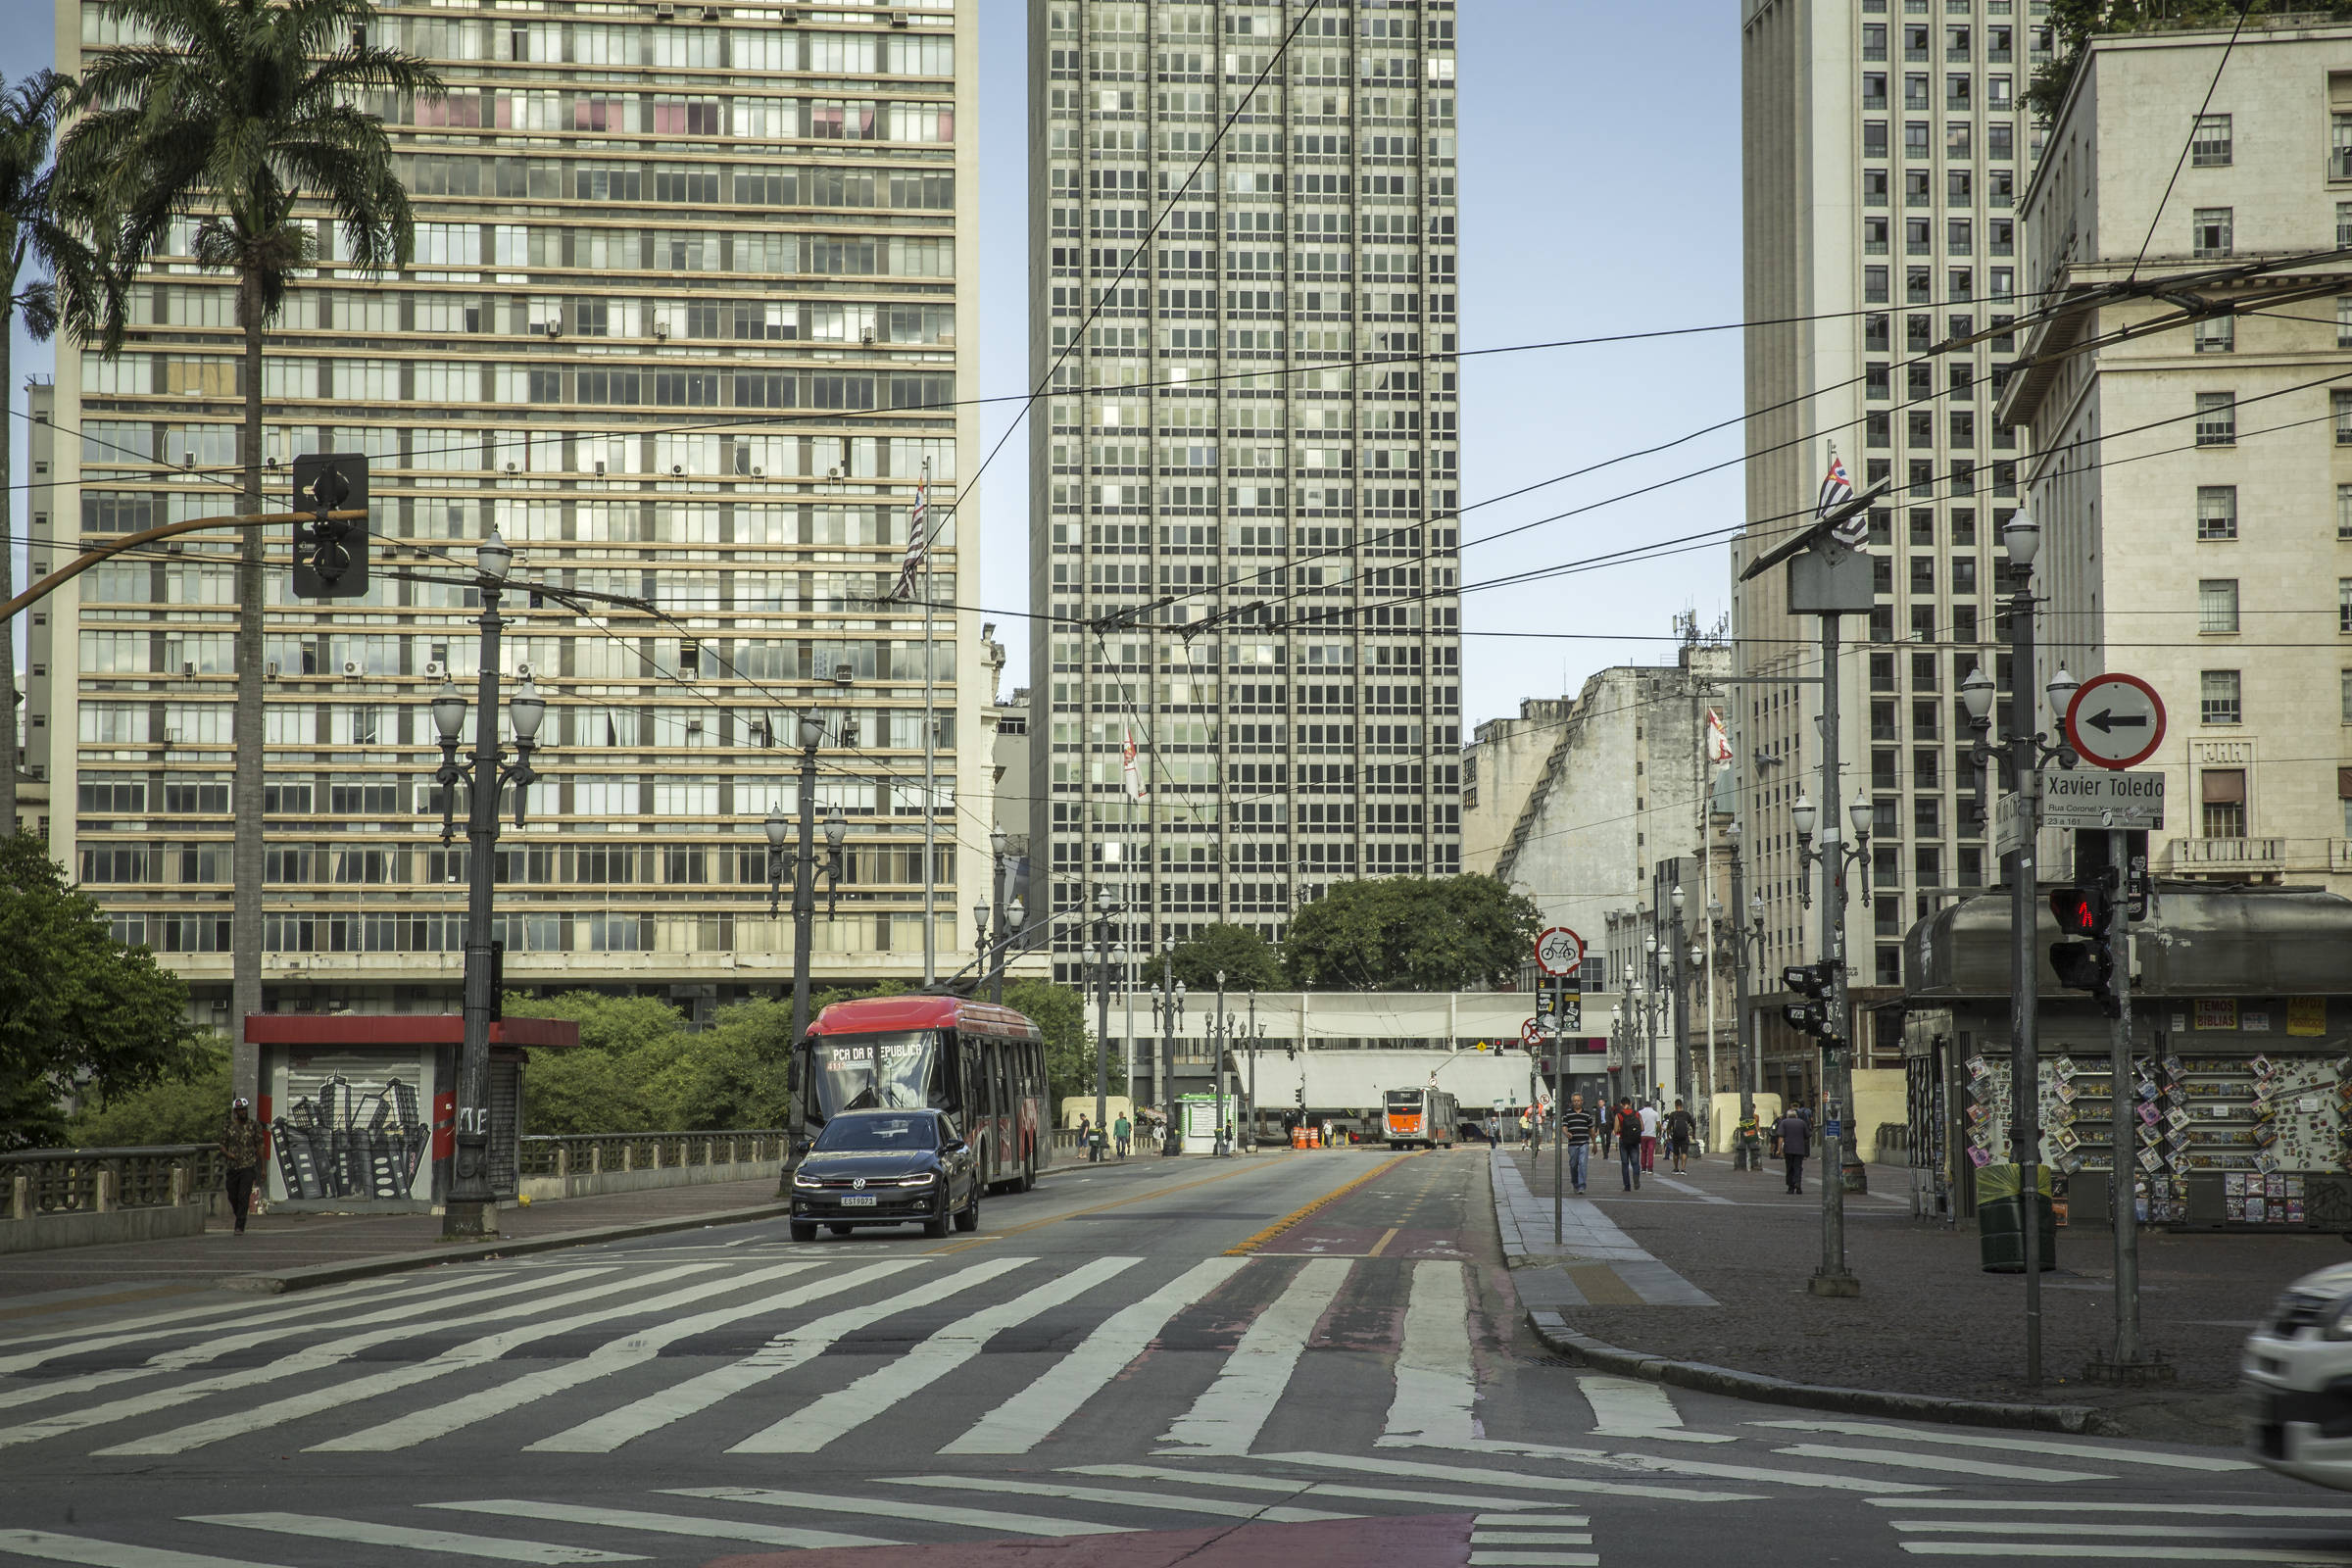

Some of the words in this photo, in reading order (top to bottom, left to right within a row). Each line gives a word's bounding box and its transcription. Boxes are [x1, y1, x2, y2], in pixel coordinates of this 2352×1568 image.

[2048, 776, 2101, 796] Xavier
[2109, 776, 2164, 797] Toledo
[2198, 1001, 2233, 1011] TEMOS
[833, 1048, 851, 1061] PCA
[853, 1048, 864, 1060] DA
